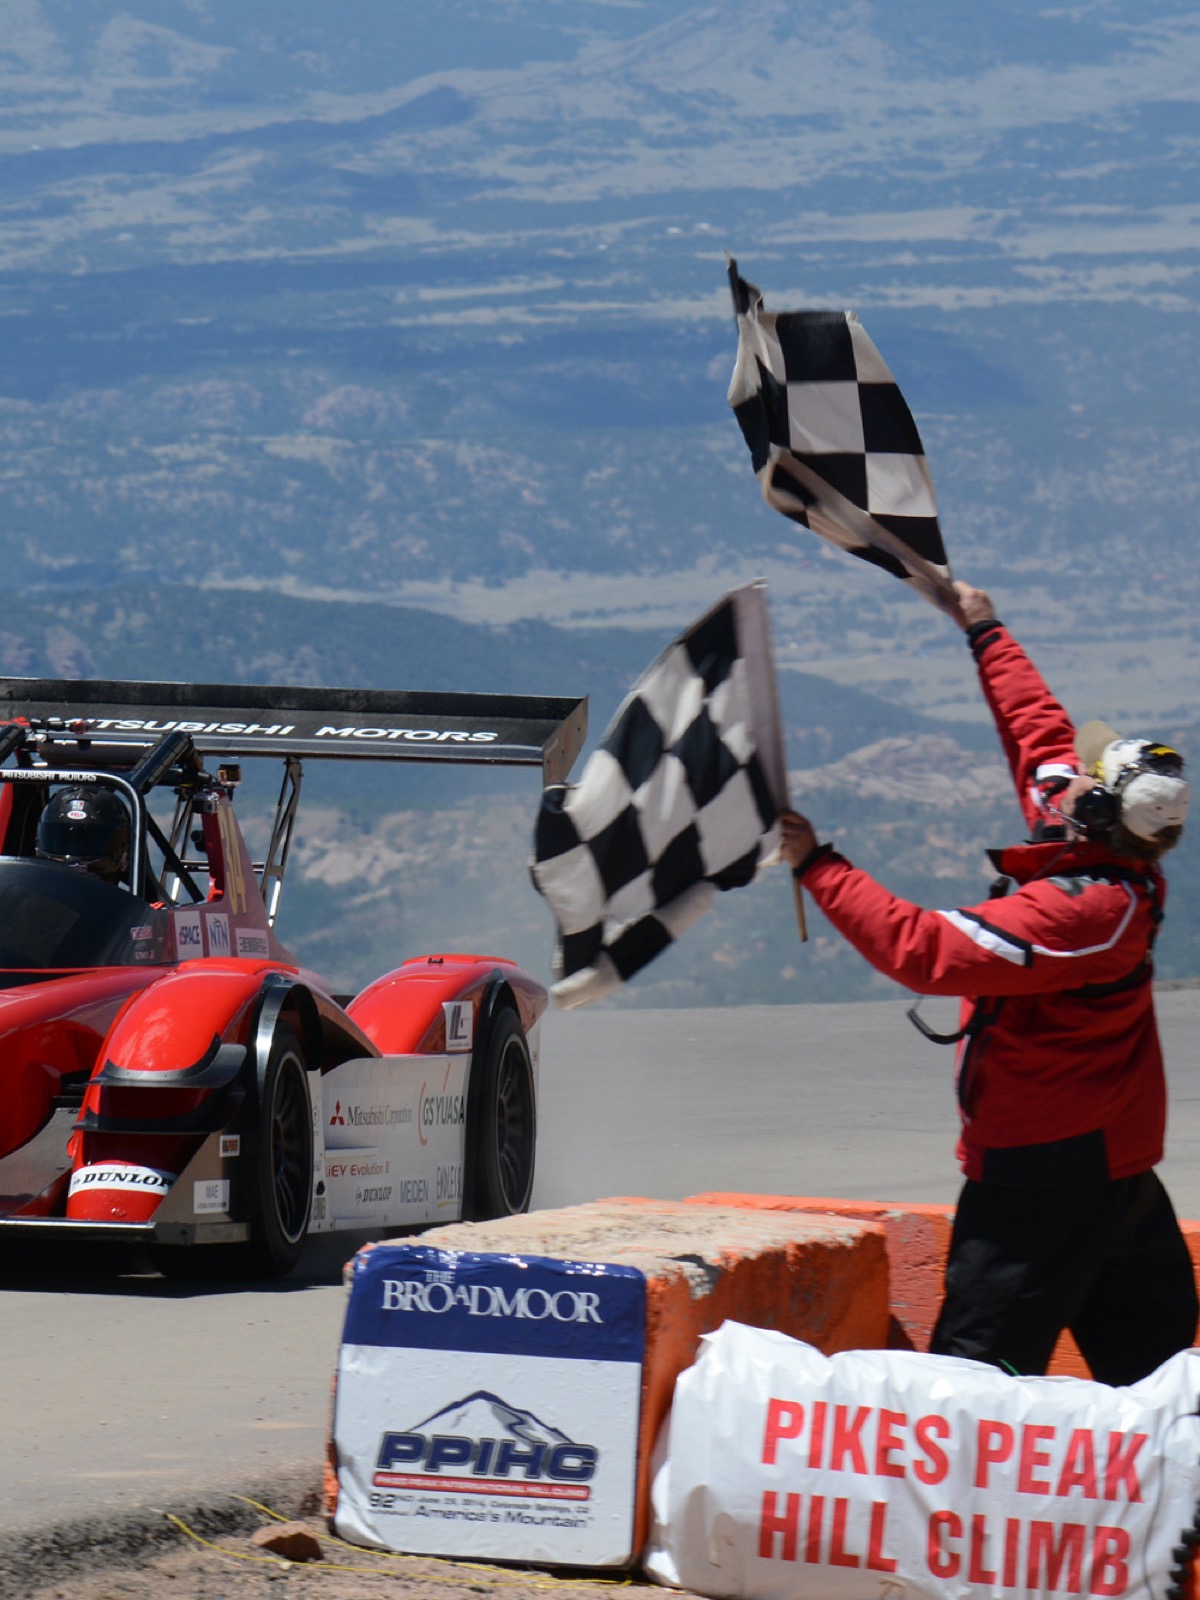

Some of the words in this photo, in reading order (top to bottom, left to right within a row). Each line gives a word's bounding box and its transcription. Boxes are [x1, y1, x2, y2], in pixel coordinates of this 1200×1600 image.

[48, 717, 295, 735] TSUBISHI
[314, 726, 498, 742] MOTORS
[83, 1172, 174, 1188] DUNLOP
[424, 1269, 456, 1284] THE
[382, 1280, 604, 1323] BROADMOOR
[377, 1431, 599, 1481] PPIHC
[762, 1398, 950, 1485] PIKES
[975, 1419, 1148, 1503] PEAK
[414, 1505, 501, 1523] America's
[759, 1491, 897, 1573] HILL
[927, 1510, 1131, 1597] CLIMB
